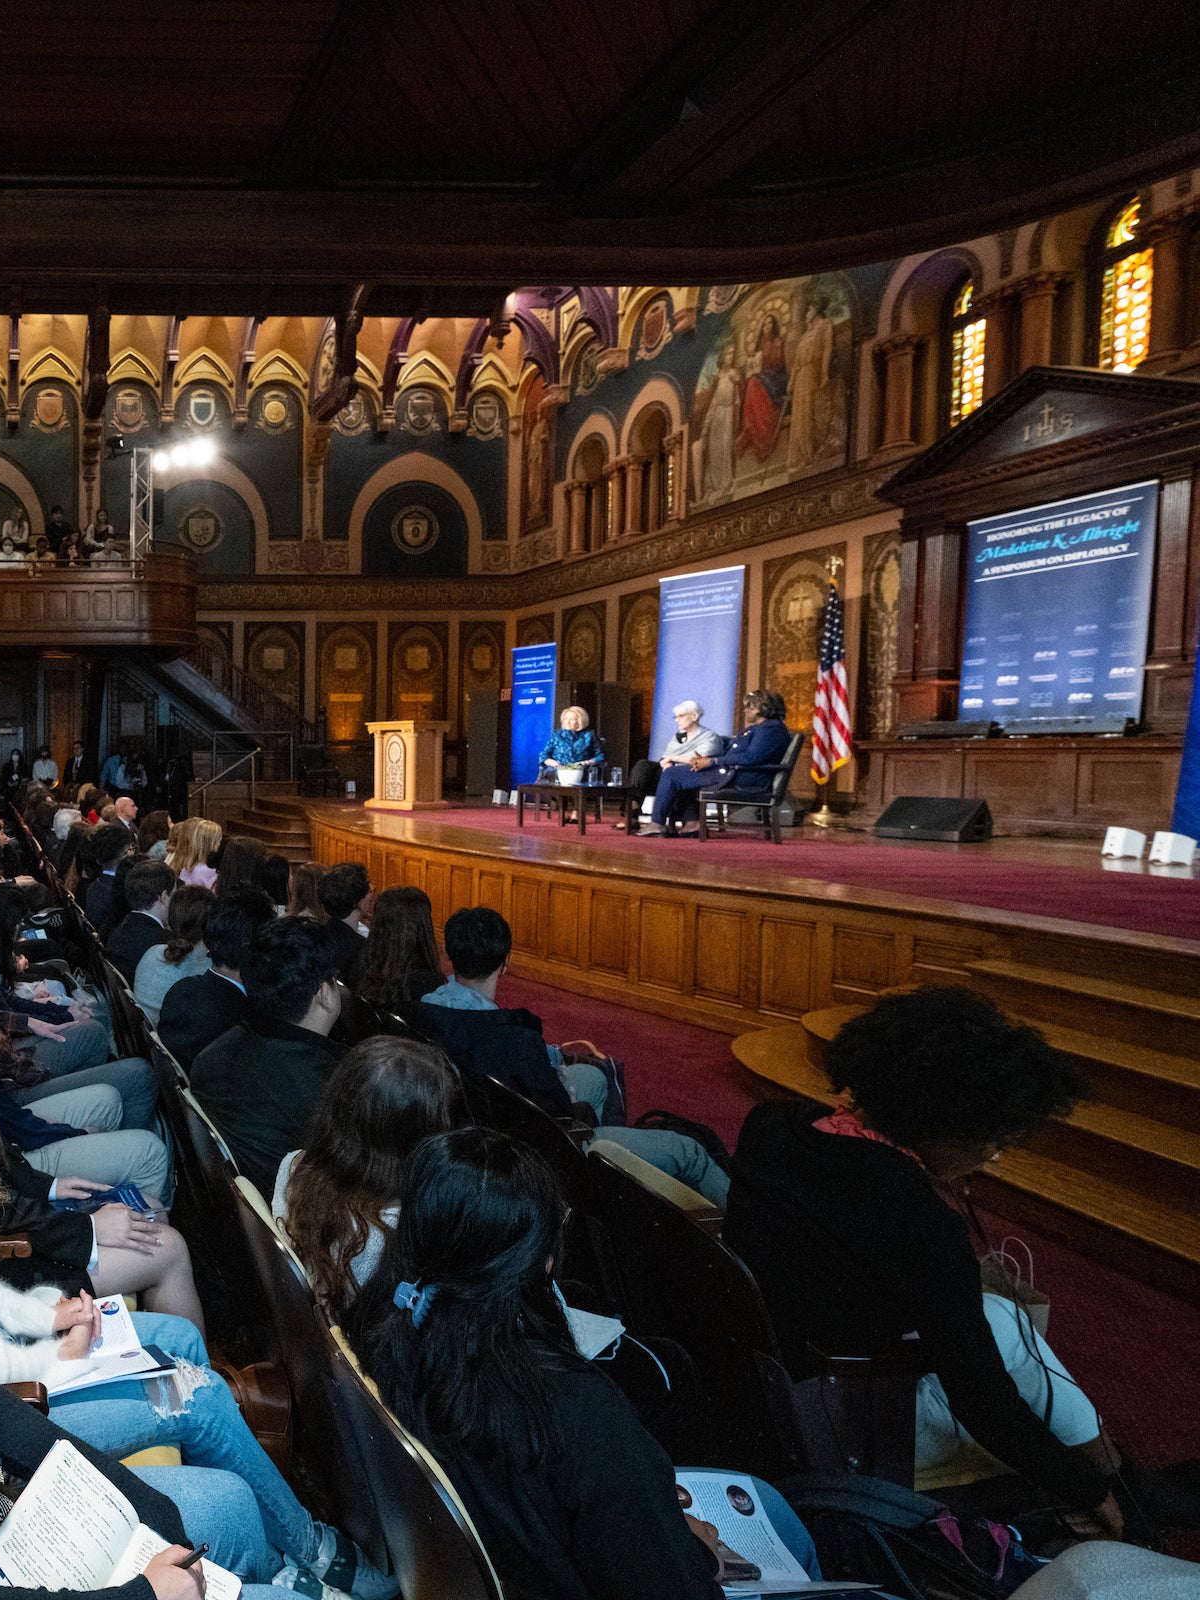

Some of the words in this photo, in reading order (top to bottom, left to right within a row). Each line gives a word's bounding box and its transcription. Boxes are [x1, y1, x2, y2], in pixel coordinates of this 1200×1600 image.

[975, 539, 1051, 563] Madeleine
[1069, 519, 1140, 545] Albright
[986, 525, 1043, 543] HONORING
[1044, 520, 1066, 532] THE
[1066, 510, 1112, 526] LEGACY
[1112, 506, 1130, 517] OF
[982, 568, 991, 576] A
[990, 557, 1046, 574] SYMPOSIUM
[1046, 554, 1064, 565] ON
[1064, 543, 1130, 562] DIPLOMACY
